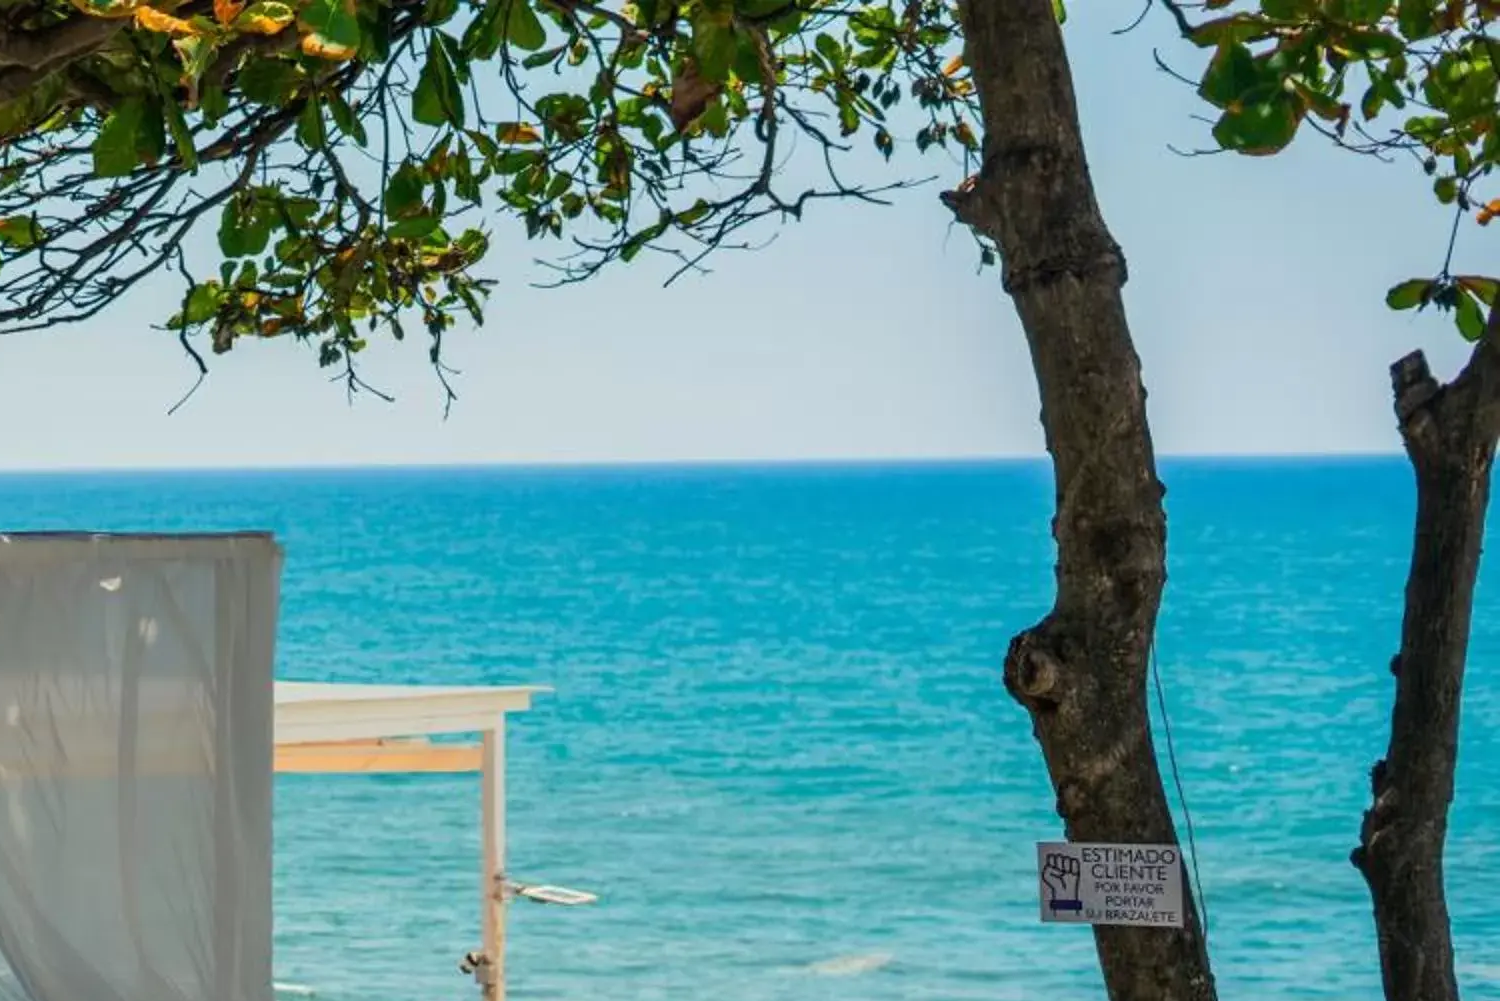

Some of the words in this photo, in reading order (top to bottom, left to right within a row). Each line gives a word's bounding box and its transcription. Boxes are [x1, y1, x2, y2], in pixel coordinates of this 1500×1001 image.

[1082, 848, 1175, 864] ESTIMADO
[1092, 864, 1167, 881] CLIENTE
[1095, 882, 1121, 893] POR
[1124, 883, 1164, 895] FAVOR
[1106, 896, 1155, 909] PORTAR
[1106, 909, 1177, 922] BRAZALETE
